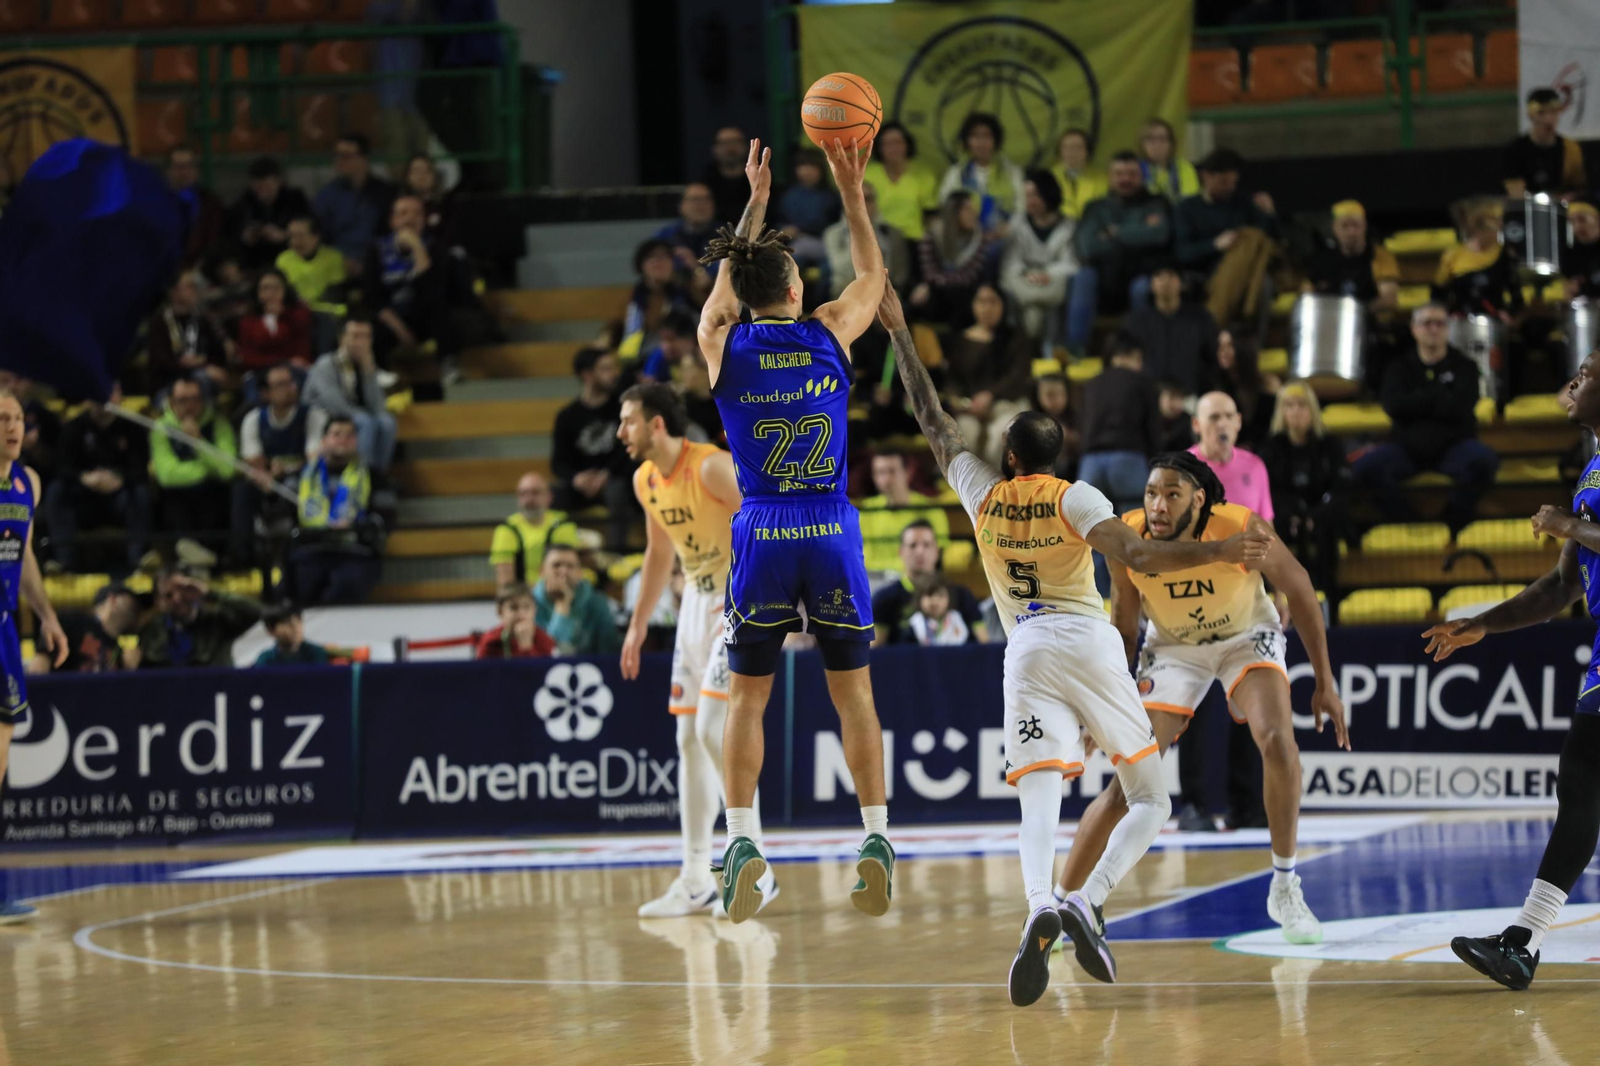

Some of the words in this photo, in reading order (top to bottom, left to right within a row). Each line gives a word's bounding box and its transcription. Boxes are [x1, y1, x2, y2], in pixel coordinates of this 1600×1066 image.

[759, 351, 813, 370] KALSCHEUR
[739, 387, 804, 405] cloud.gal
[753, 412, 836, 480] 22
[660, 506, 695, 526] TZN
[983, 499, 1057, 522] JACKSON
[754, 522, 843, 541] TRANSITERIA
[996, 535, 1065, 550] IBEREÓLICA
[1004, 559, 1042, 601] 5
[1163, 578, 1216, 600] TZN
[399, 748, 677, 804] AbrenteDix
[148, 789, 180, 812] DE
[196, 781, 316, 809] SEGUROS
